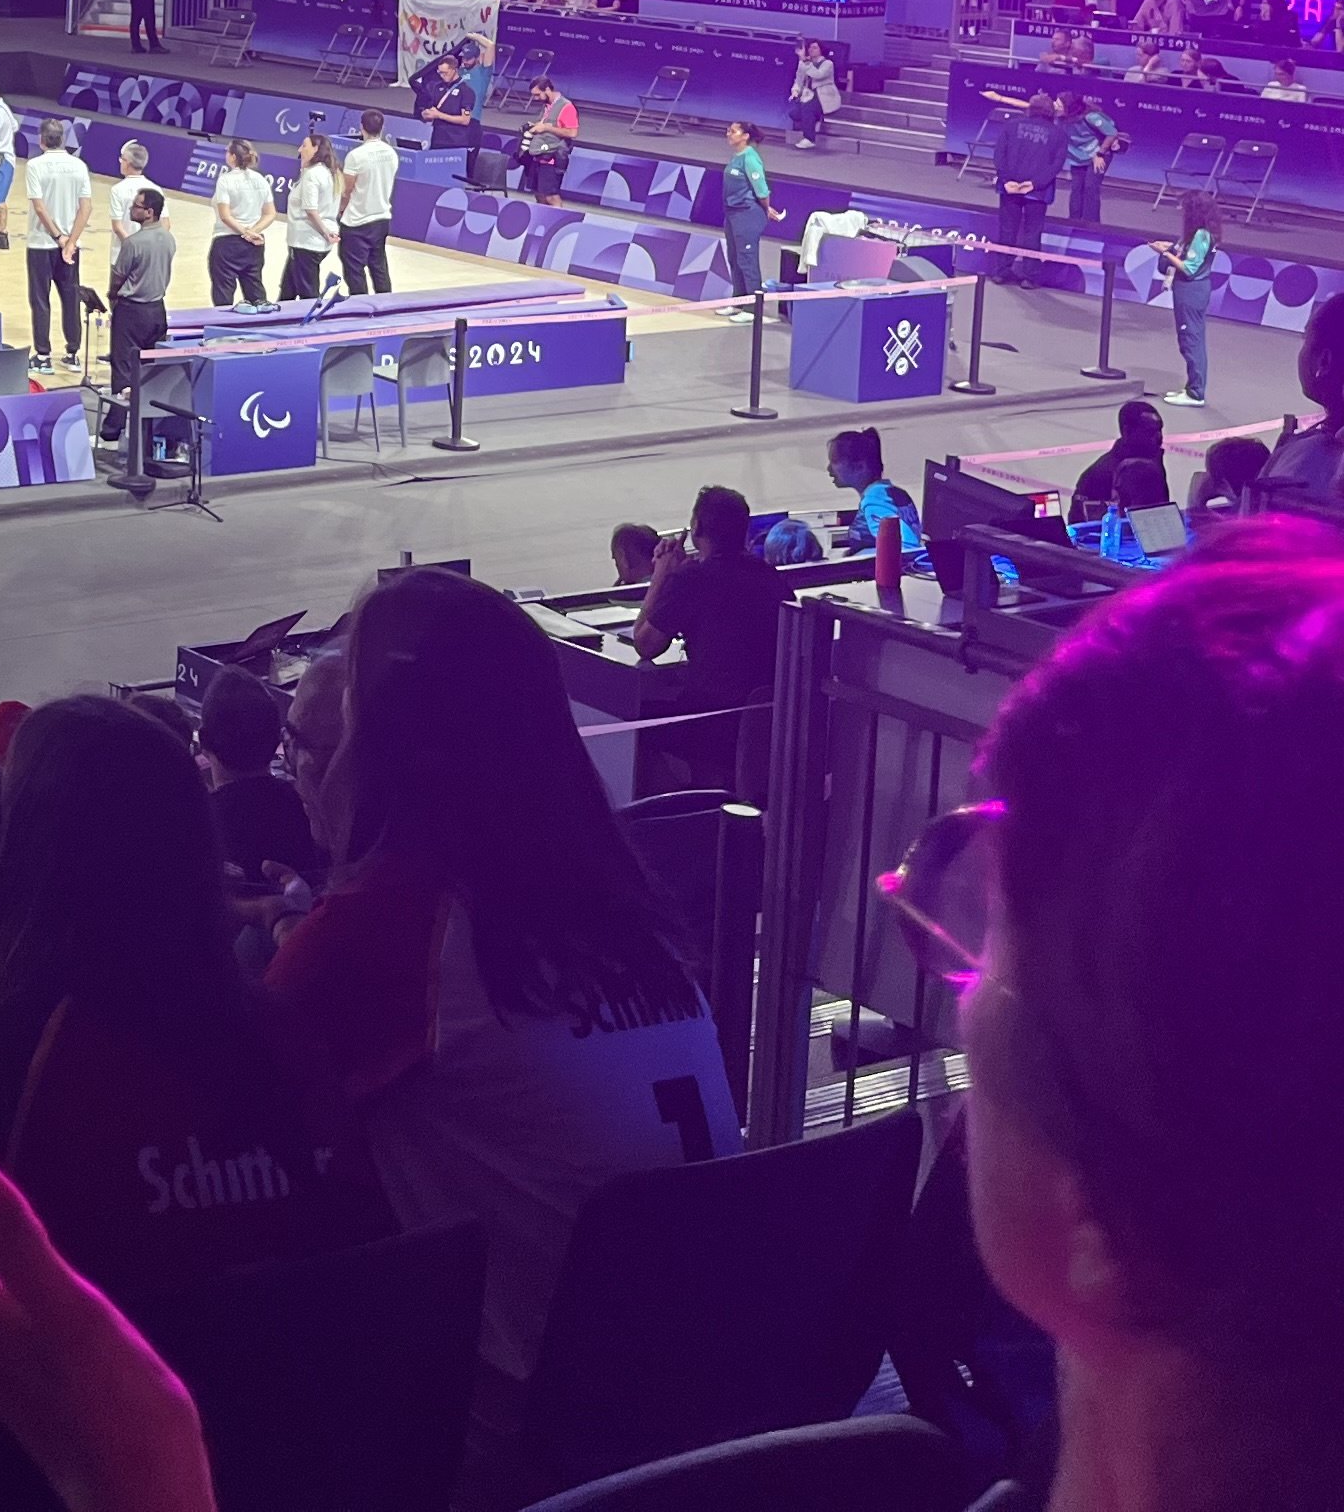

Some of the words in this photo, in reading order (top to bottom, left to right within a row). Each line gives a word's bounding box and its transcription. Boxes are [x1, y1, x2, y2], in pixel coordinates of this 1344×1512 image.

[1131, 35, 1165, 47] PARIS
[468, 339, 543, 370] 2024
[652, 1074, 713, 1164] 1
